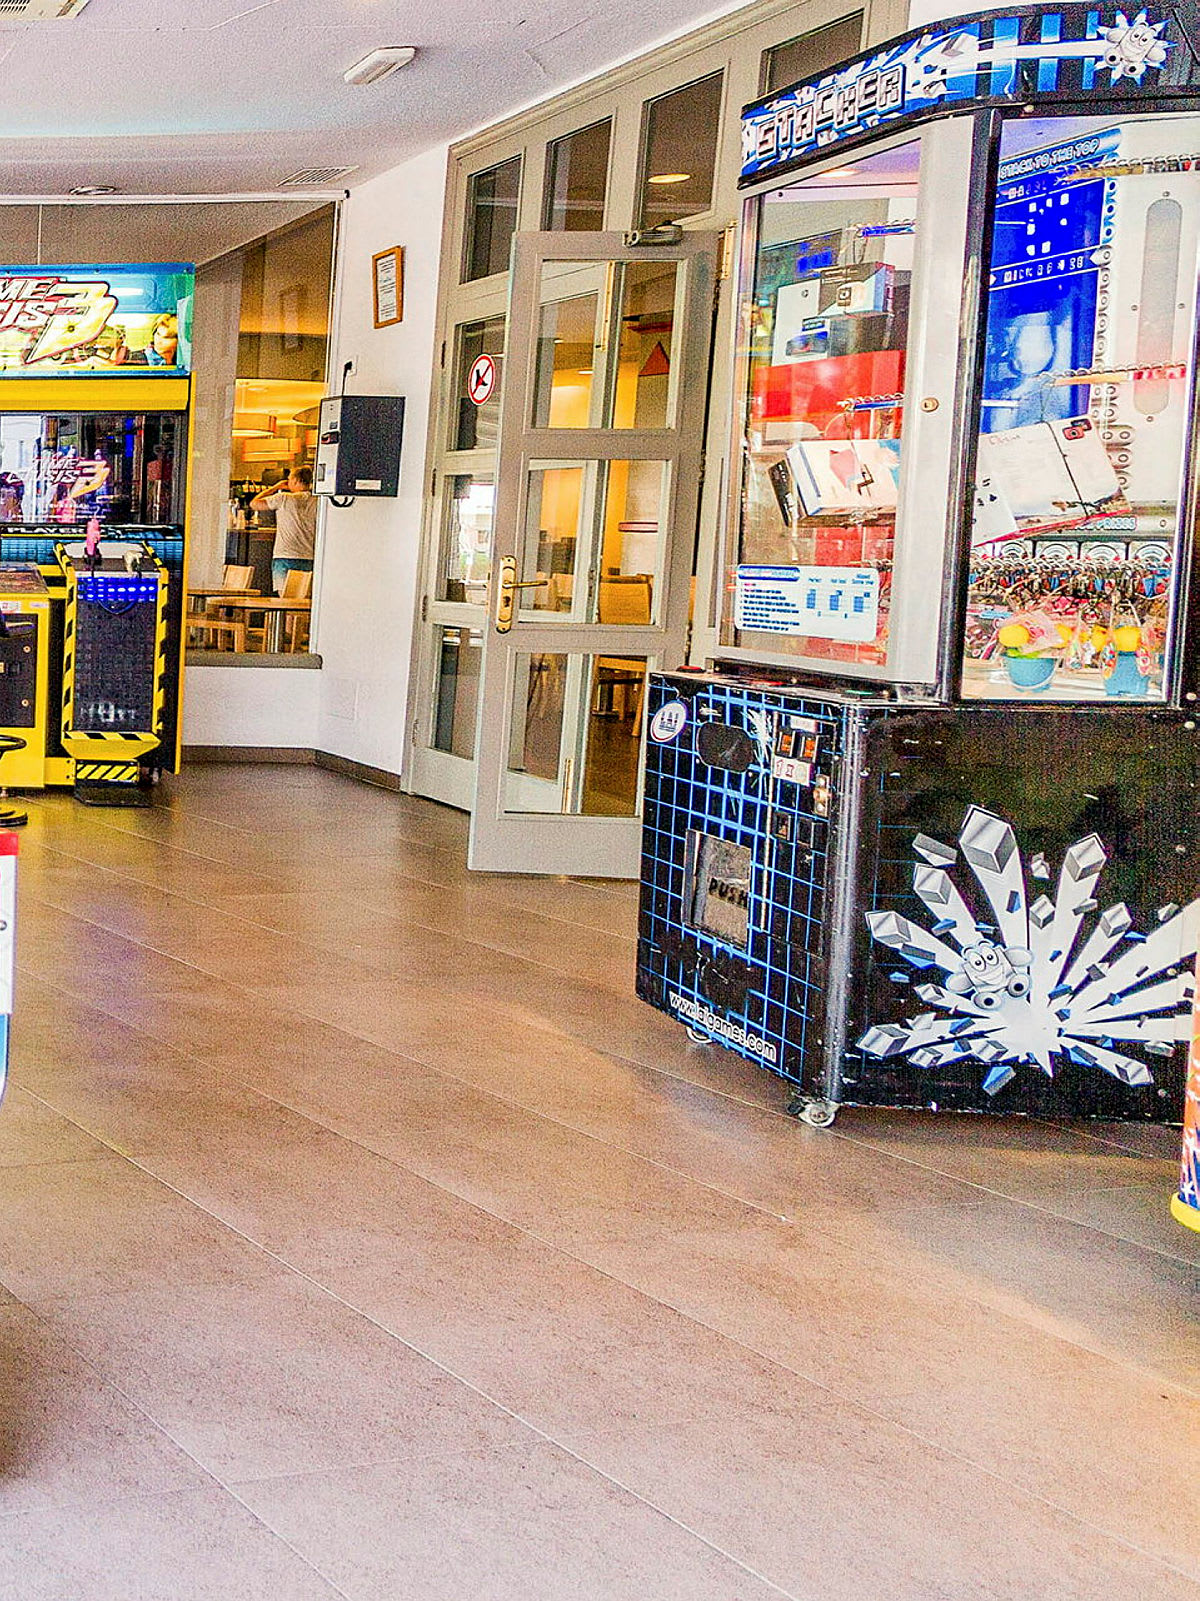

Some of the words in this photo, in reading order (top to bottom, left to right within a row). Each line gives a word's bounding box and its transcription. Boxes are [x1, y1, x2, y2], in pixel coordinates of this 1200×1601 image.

[755, 65, 905, 160] STACKER
[1000, 158, 1034, 179] STACK
[1034, 153, 1051, 170] TO
[1075, 138, 1100, 158] TOP
[22, 281, 119, 364] 3
[7, 526, 85, 535] PLAYER
[708, 877, 749, 908] PUSH
